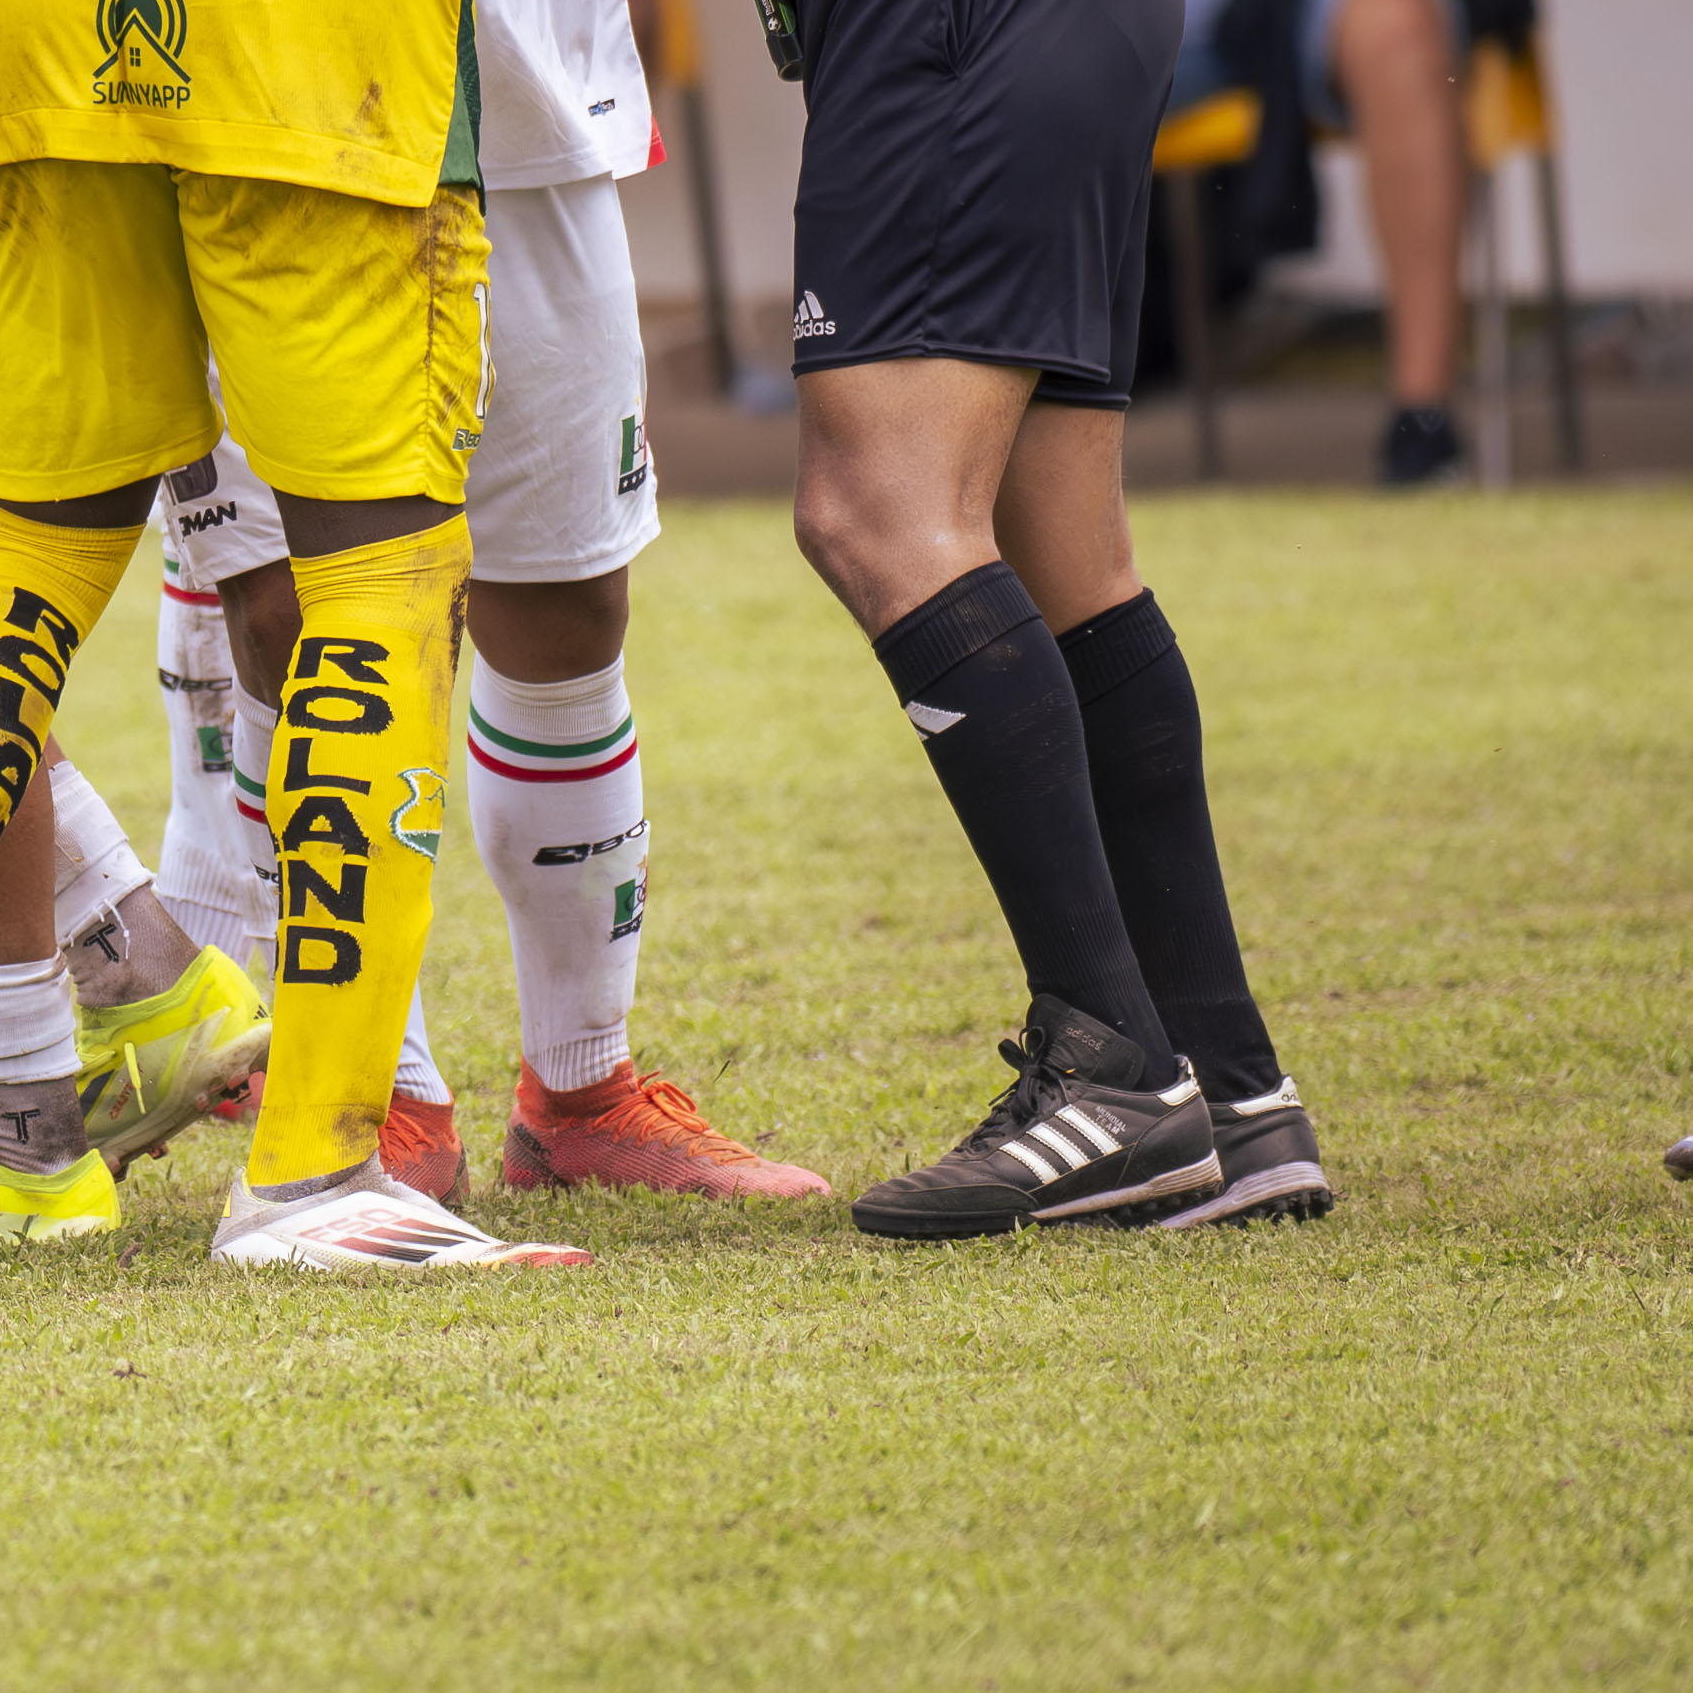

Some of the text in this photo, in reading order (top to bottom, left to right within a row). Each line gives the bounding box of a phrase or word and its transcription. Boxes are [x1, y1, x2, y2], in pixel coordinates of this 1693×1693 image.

[92, 81, 191, 110] SUNNYAPP
[282, 637, 394, 987] ROLAND
[1095, 1115, 1120, 1135] TEAM
